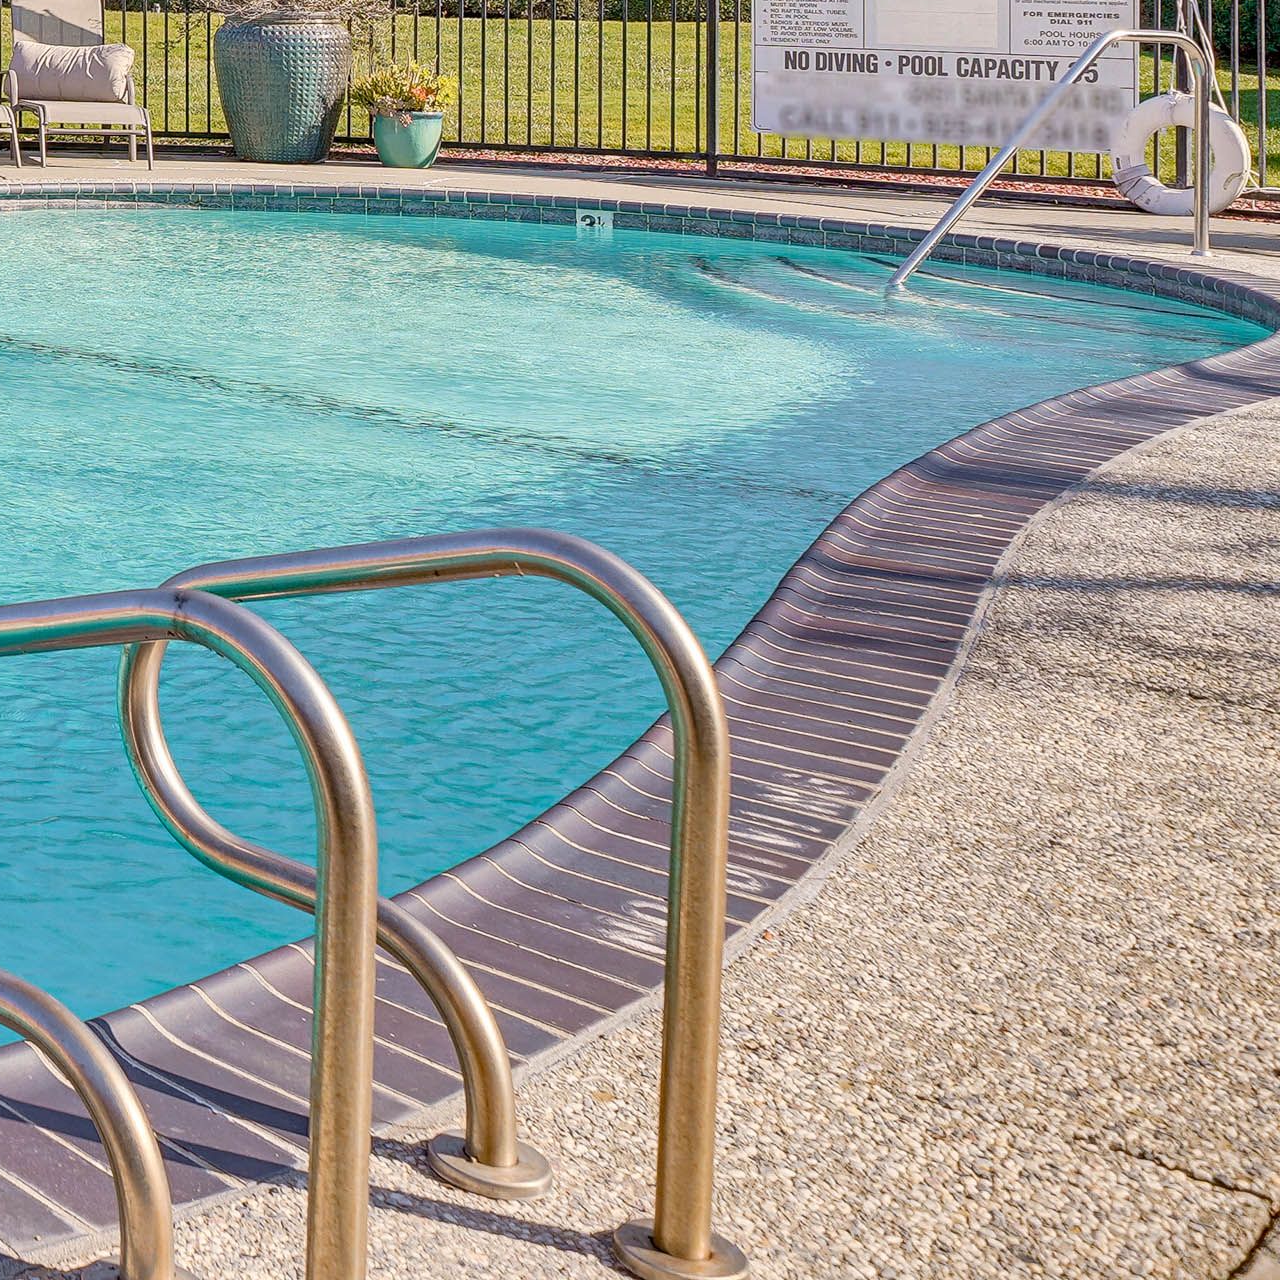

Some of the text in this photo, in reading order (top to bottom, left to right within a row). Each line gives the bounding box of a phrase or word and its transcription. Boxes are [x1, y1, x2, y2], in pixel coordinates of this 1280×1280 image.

[784, 50, 809, 71] NO
[815, 51, 879, 74] DIVING
[898, 55, 948, 77] POOL
[956, 57, 1058, 81] CAPACITY
